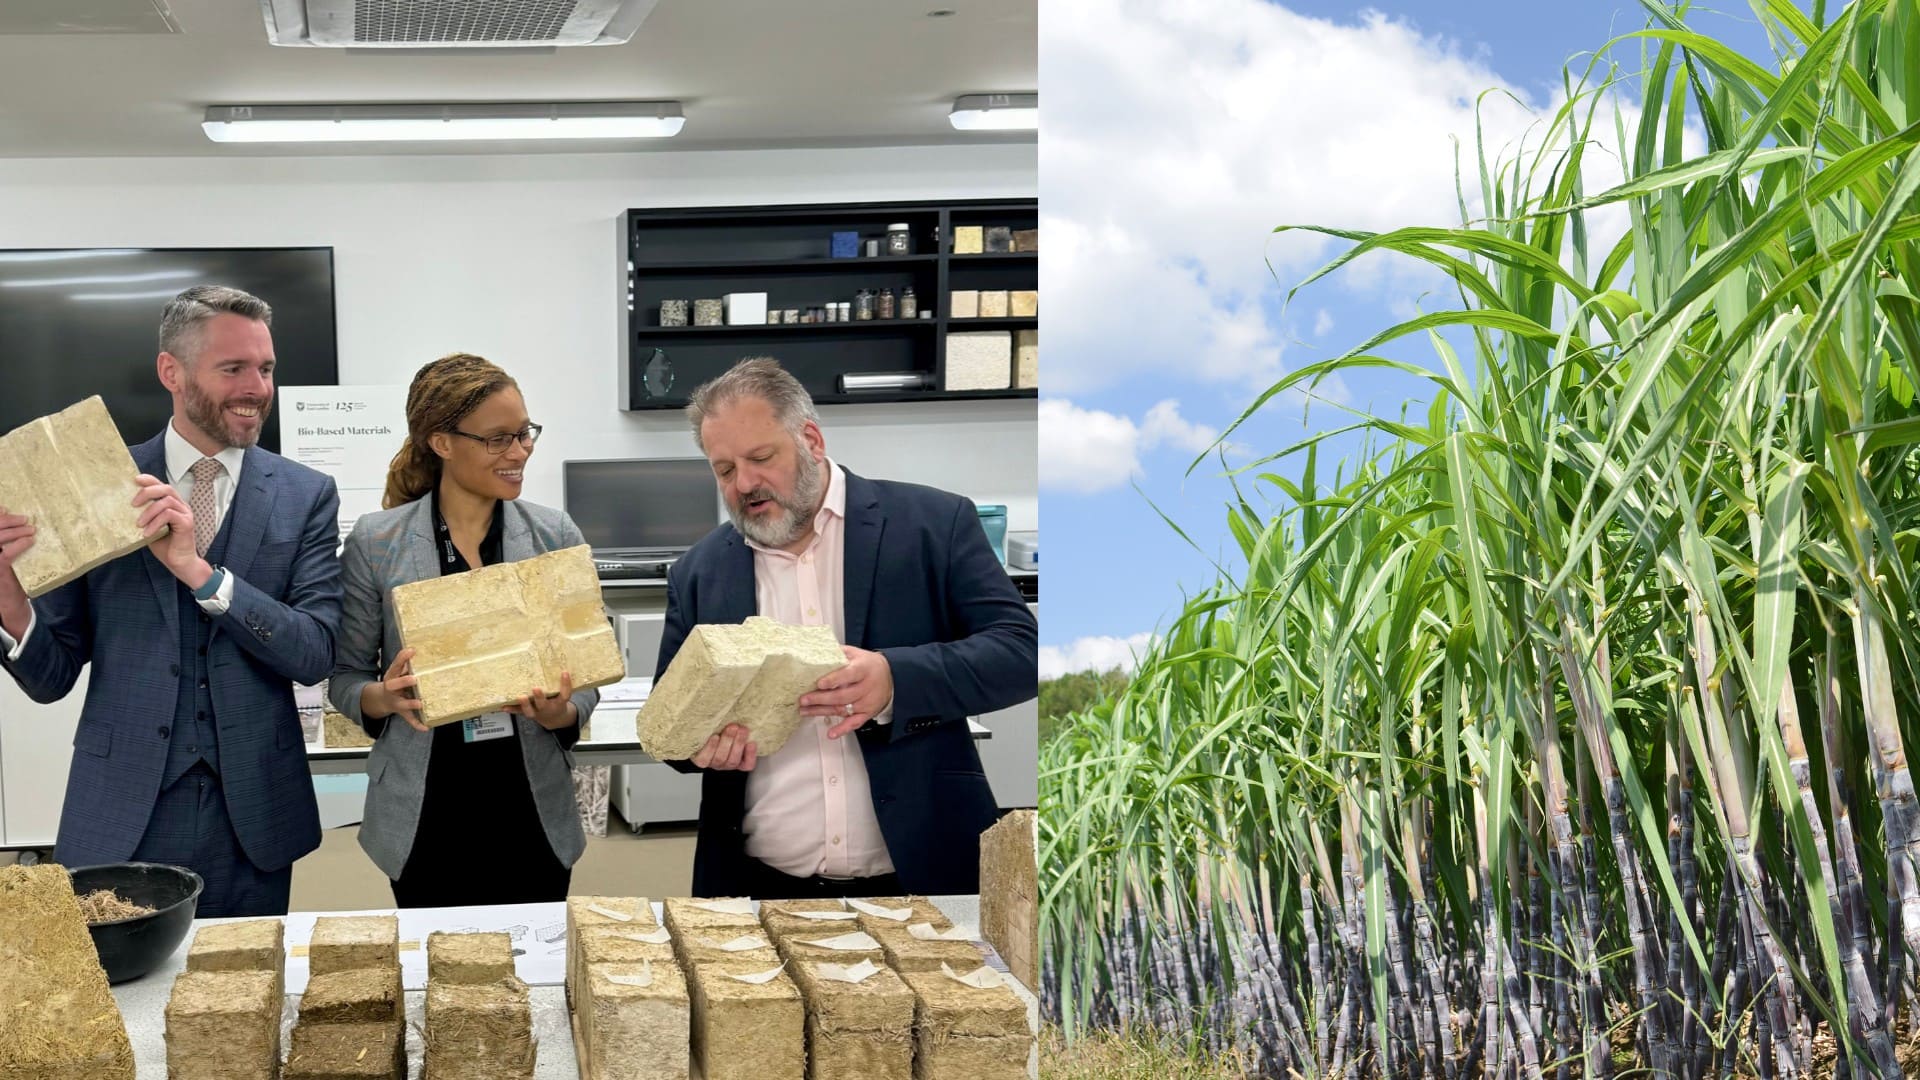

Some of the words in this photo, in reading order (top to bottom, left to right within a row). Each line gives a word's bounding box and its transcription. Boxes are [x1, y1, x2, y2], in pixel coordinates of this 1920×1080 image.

[336, 402, 353, 412] 125
[298, 427, 345, 436] Bio-Based
[347, 425, 391, 435] Materials
